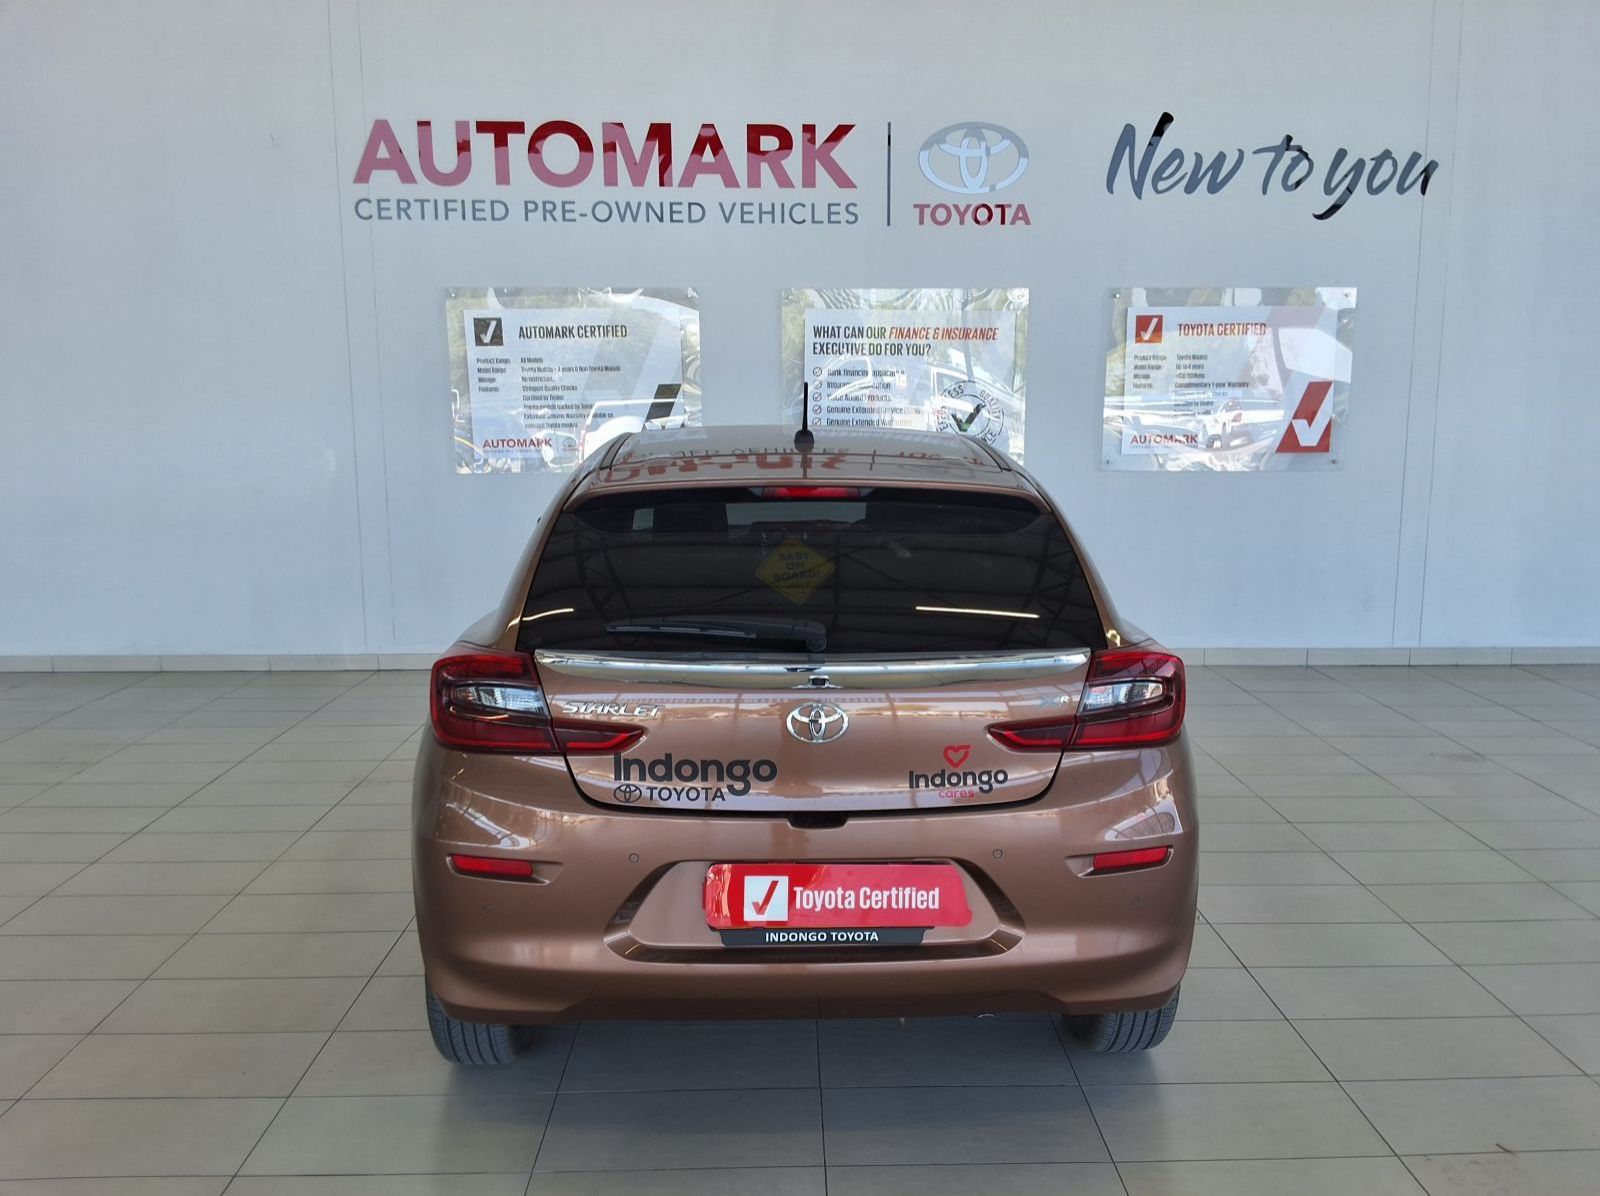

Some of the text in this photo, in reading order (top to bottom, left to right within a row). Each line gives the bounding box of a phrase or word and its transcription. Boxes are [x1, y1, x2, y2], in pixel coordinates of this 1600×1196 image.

[352, 118, 859, 189] AUTOMARK
[1106, 110, 1440, 221] New to you
[354, 198, 860, 226] CERTIFIED PRE-OWNED VEHICLES
[912, 203, 1032, 226] TOYOTA
[518, 325, 628, 340] AUTOMARK CERTIFIED
[813, 325, 842, 339] WHAT
[843, 325, 864, 339] CAN
[866, 326, 887, 340] OUR
[888, 326, 931, 340] FINANCE
[941, 326, 999, 341] INSURANCE
[1177, 323, 1266, 337] TOYOTA CERTIFIED
[812, 342, 932, 356] EXECUTIVE DO FOR YOU?
[482, 437, 553, 449] AUTOMARK
[562, 700, 666, 717] STARLET
[613, 752, 778, 797] Indongo
[908, 768, 1009, 794] Indongo
[646, 786, 726, 802] TOYOTA
[938, 787, 975, 799] cares
[793, 886, 940, 912] Toyota Certified
[765, 931, 879, 943] INDONGO TOYOTA
